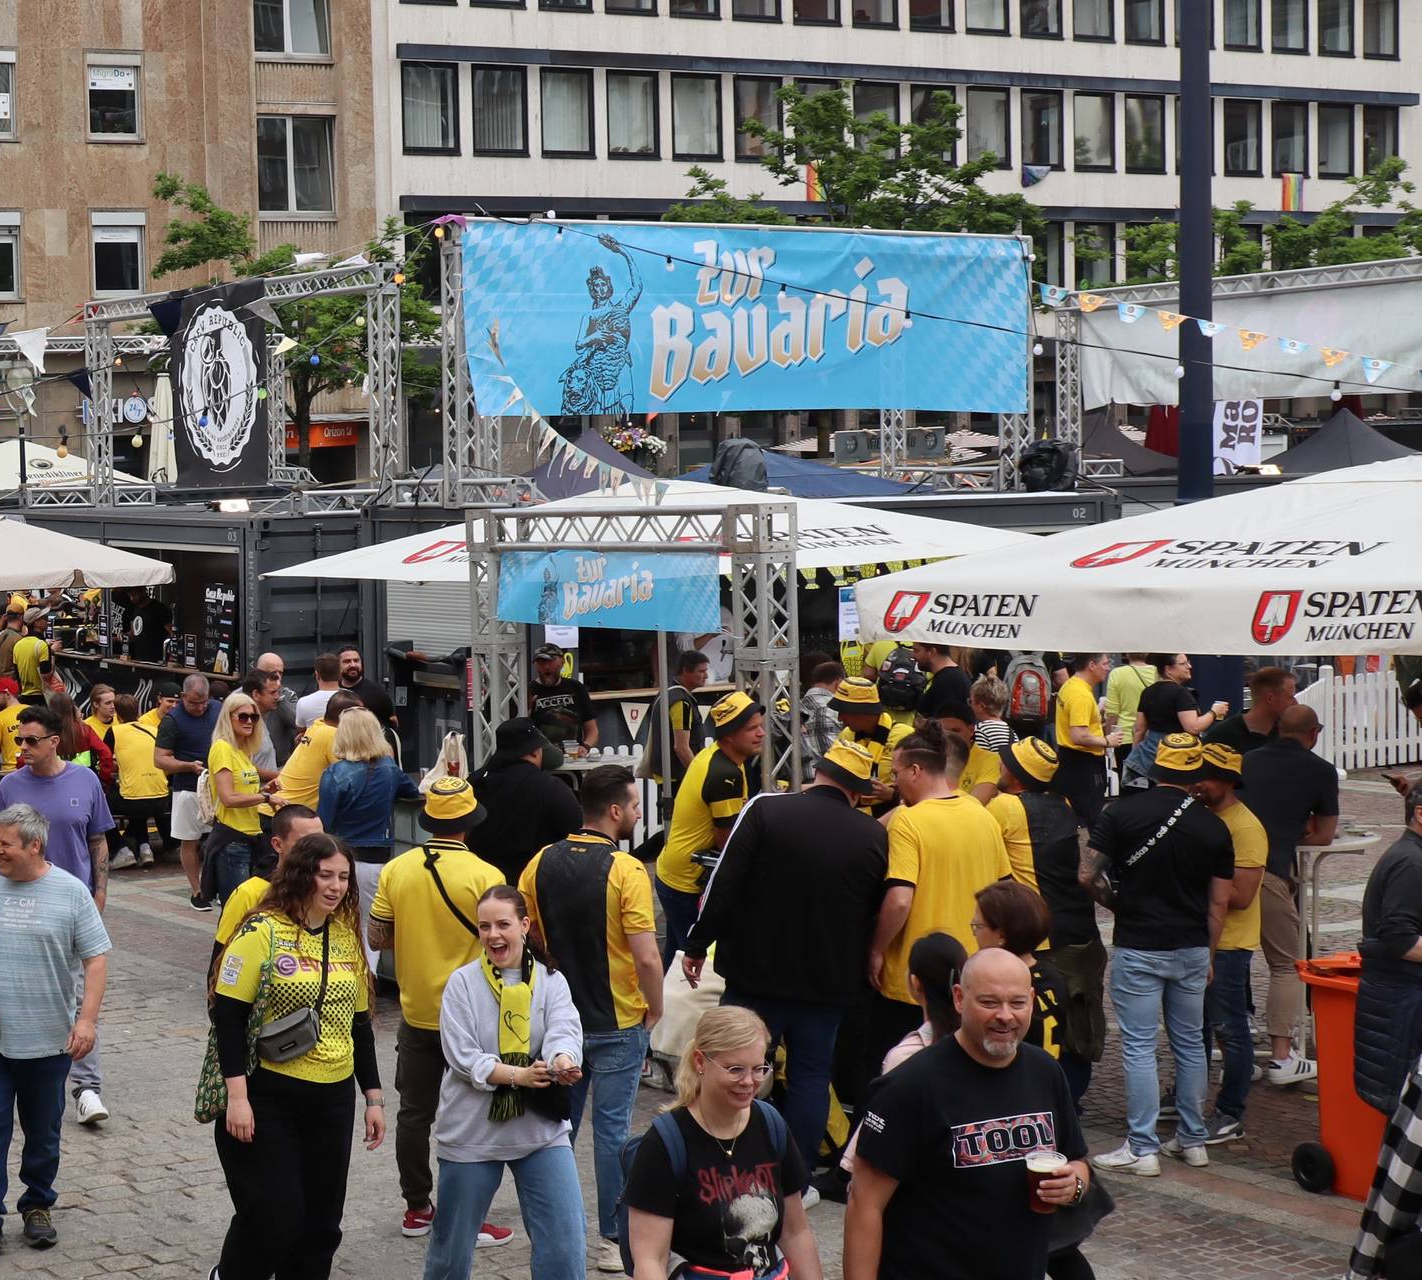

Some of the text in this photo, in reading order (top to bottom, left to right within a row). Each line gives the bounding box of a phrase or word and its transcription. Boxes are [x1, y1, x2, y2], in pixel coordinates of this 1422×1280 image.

[649, 256, 909, 402] Bavaria
[1072, 508, 1086, 519] 02
[227, 531, 238, 542] 03
[1162, 540, 1394, 557] SPATEN
[563, 561, 655, 620] Bavaria
[929, 593, 1039, 617] SPATEN
[1305, 622, 1416, 642] MÜNCHEN
[957, 1122, 1054, 1156] TOOL
